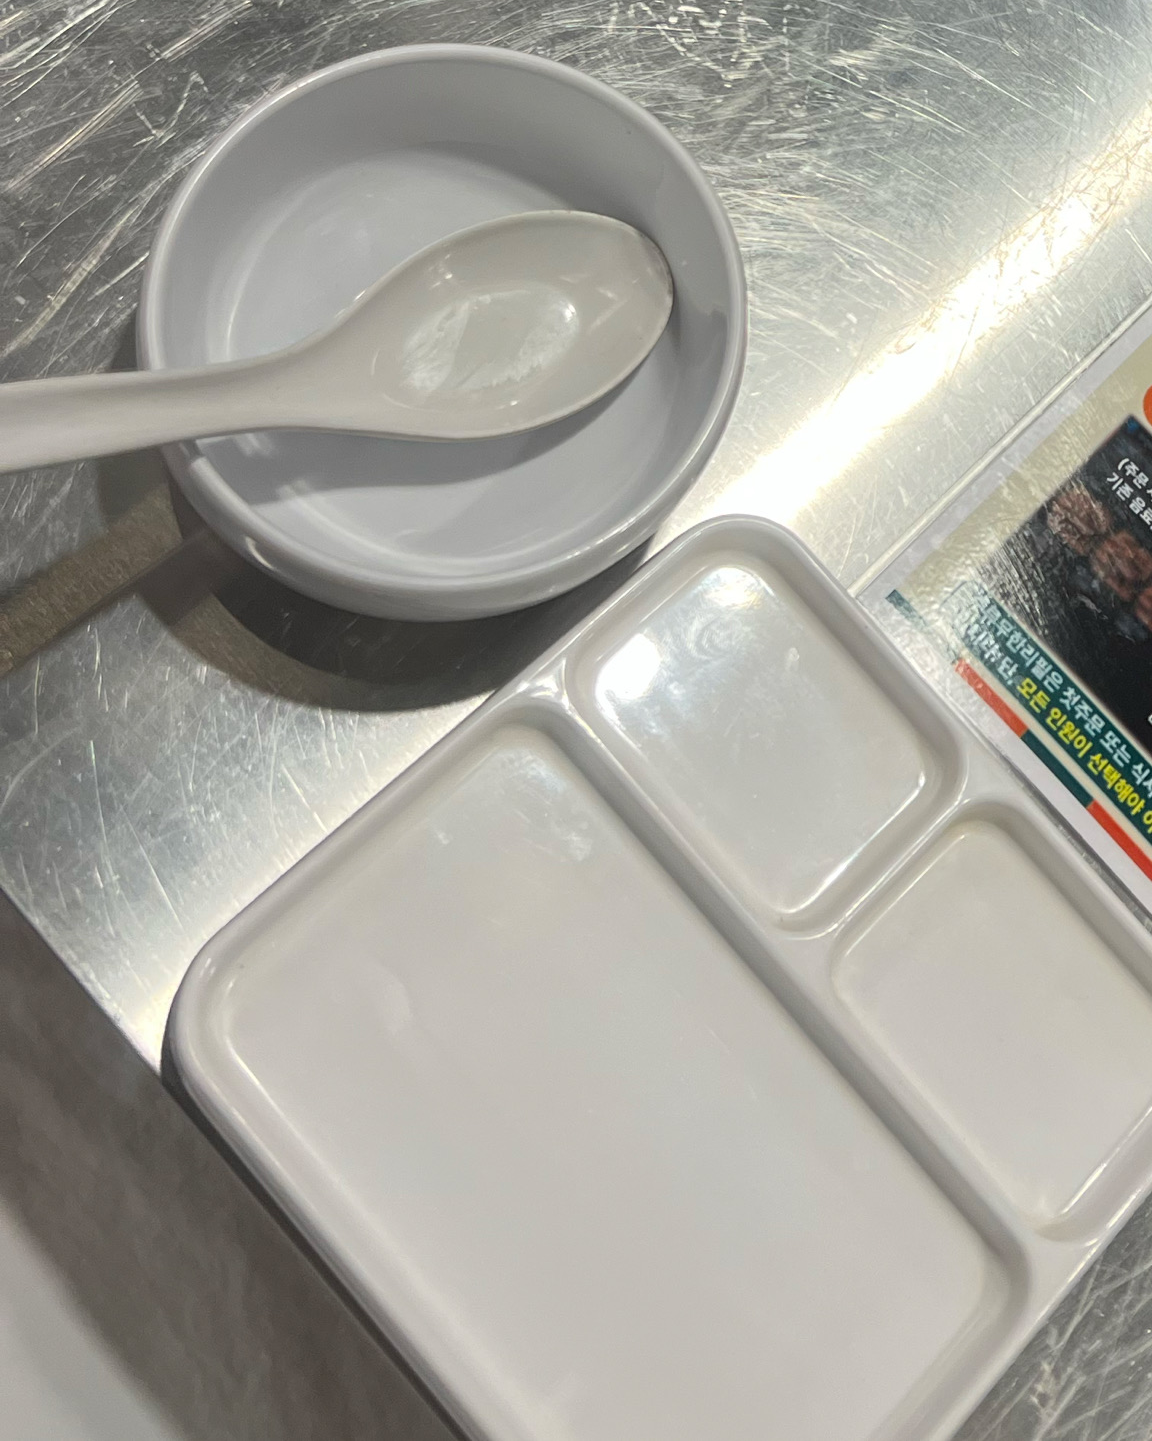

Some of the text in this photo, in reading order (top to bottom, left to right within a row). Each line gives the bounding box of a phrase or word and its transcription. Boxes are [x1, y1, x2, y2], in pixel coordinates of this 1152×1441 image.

[1105, 472, 1134, 501] 기존
[1117, 457, 1150, 490] (주문
[1016, 676, 1051, 713] 모든
[1044, 707, 1092, 759] 인원이
[1086, 752, 1146, 816] 선택해야
[1059, 686, 1106, 738] 첫주문
[1099, 730, 1132, 768] 또는
